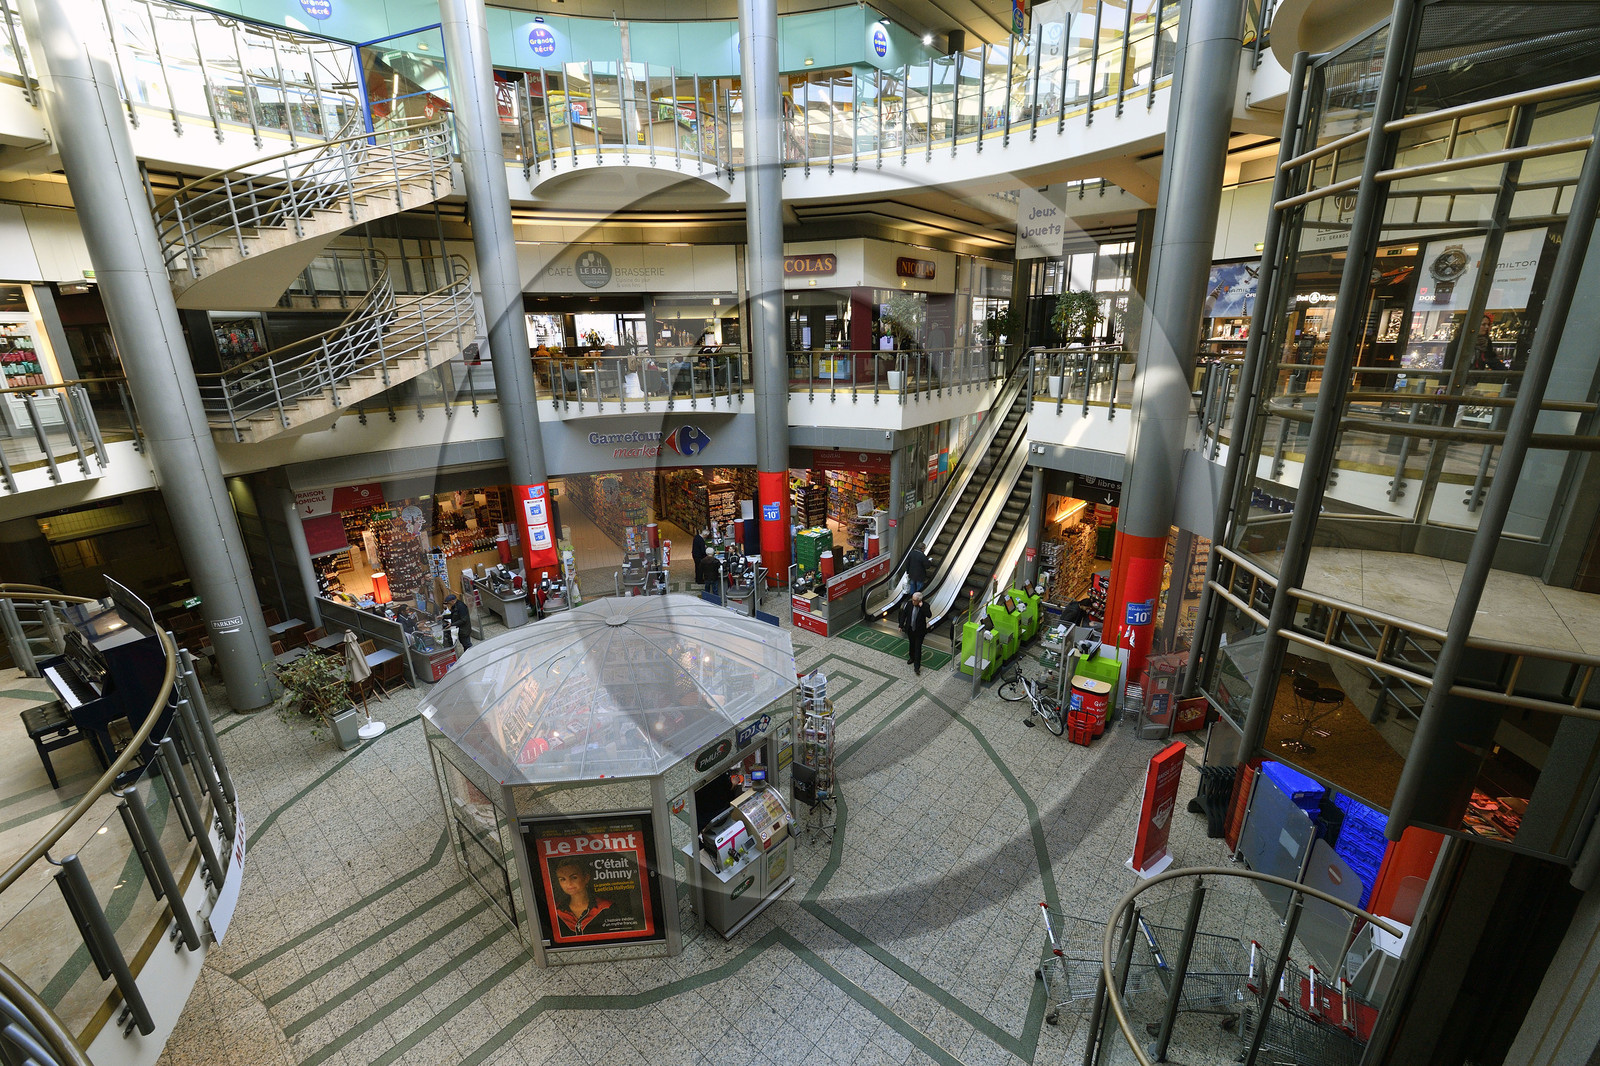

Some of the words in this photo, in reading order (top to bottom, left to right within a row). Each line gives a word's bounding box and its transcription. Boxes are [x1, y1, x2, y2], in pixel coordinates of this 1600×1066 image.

[534, 45, 554, 53] Récré
[1029, 207, 1056, 220] Jeux
[1021, 223, 1061, 239] Jouets
[547, 265, 573, 277] CAFÉ
[579, 267, 590, 275] LE
[591, 267, 608, 275] BAL
[614, 267, 665, 277] BRASSERIE
[901, 261, 934, 276] NICOLAS
[589, 431, 663, 445] Carrefour
[613, 444, 662, 458] market
[1097, 480, 1116, 489] libre
[213, 618, 240, 628] PARKING
[740, 726, 757, 743] FDJ
[520, 743, 545, 763] ELLE
[699, 749, 718, 769] PMU
[544, 840, 571, 855] Le
[574, 833, 637, 852] Point
